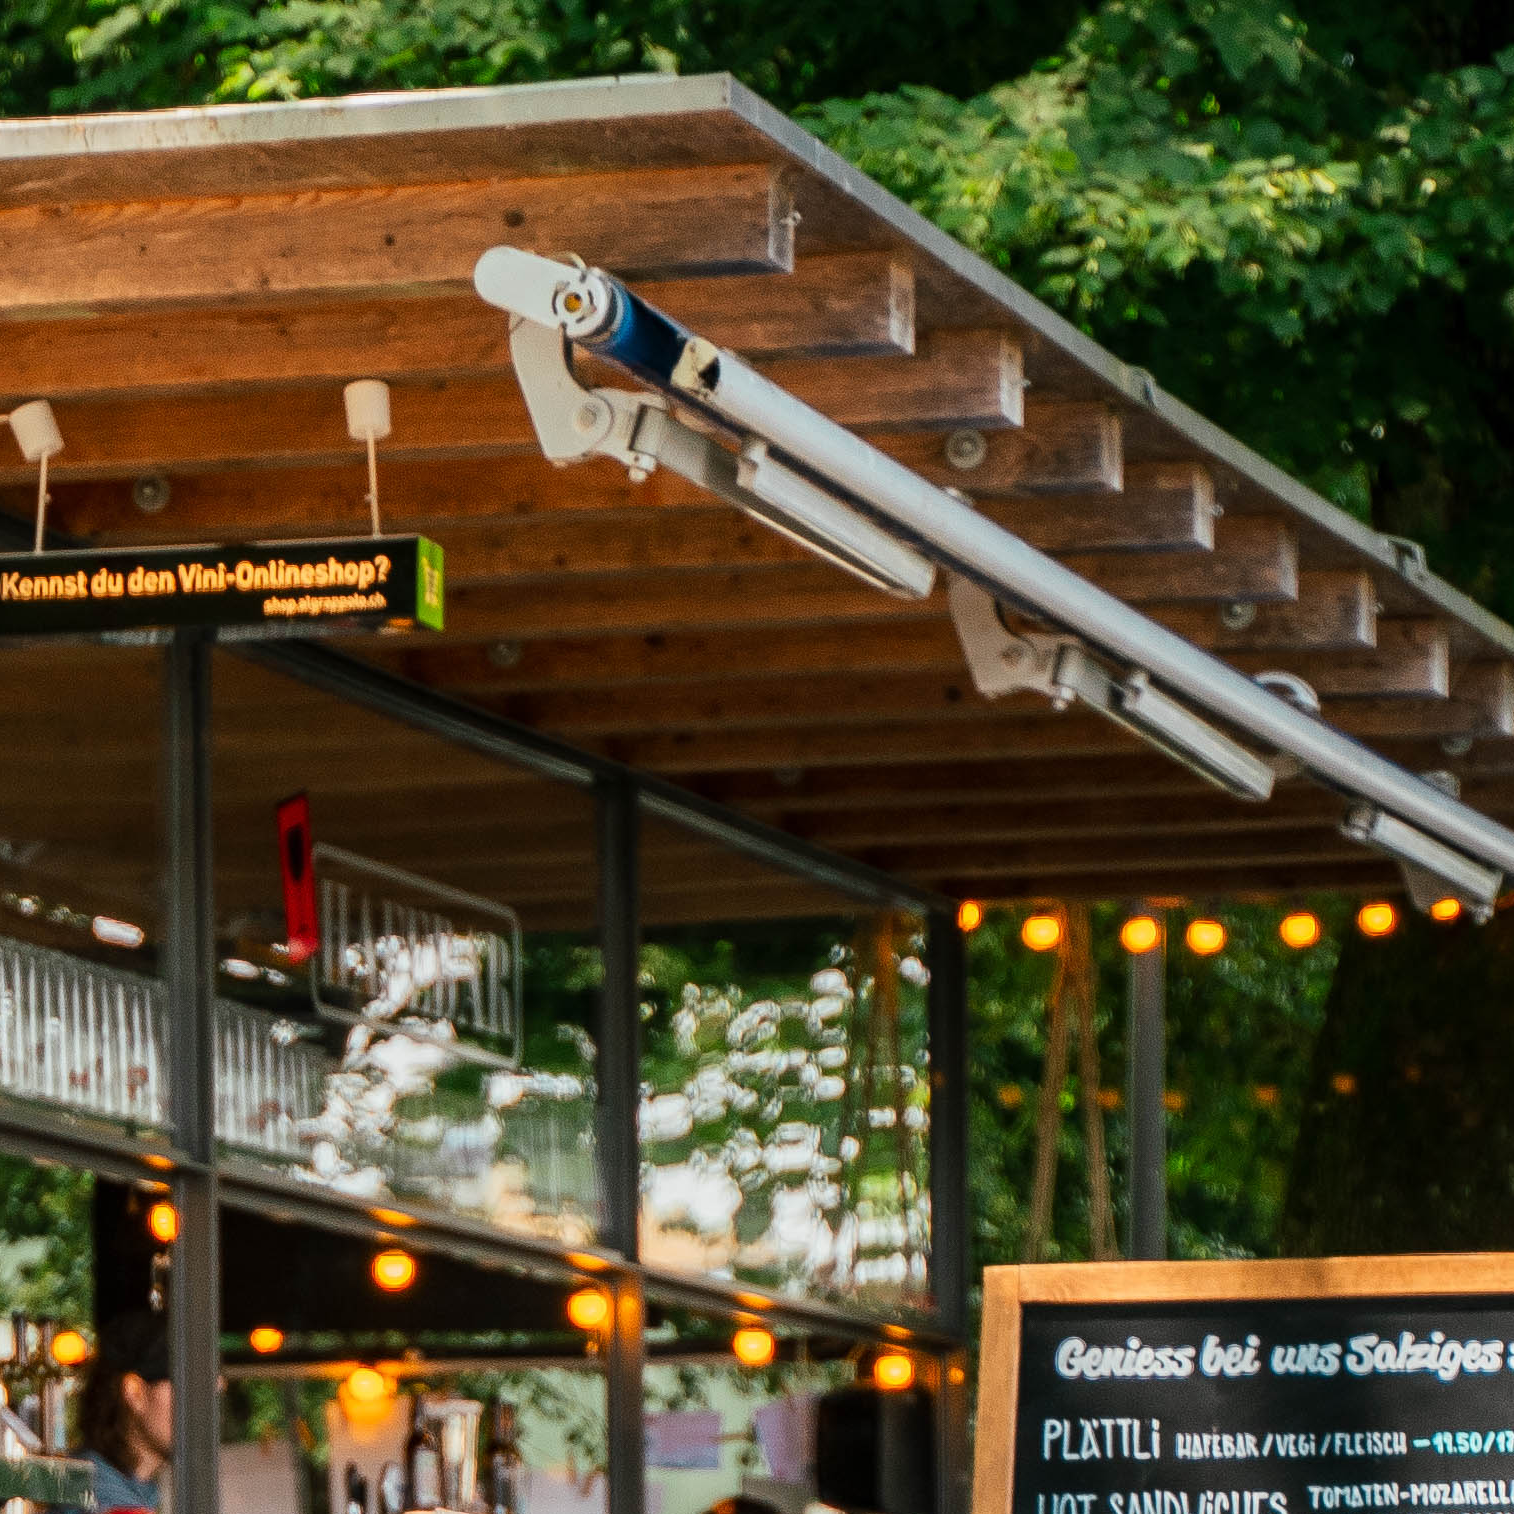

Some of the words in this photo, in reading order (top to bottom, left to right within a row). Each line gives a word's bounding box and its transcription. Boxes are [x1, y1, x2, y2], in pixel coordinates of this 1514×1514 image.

[0, 571, 88, 600] Kennst
[91, 568, 123, 597] du
[128, 566, 175, 594] den
[179, 555, 390, 592] Vini-Onlineshop?
[1056, 1336, 1194, 1379] Geniess
[1200, 1335, 1259, 1375] bei
[1271, 1343, 1341, 1375] uns
